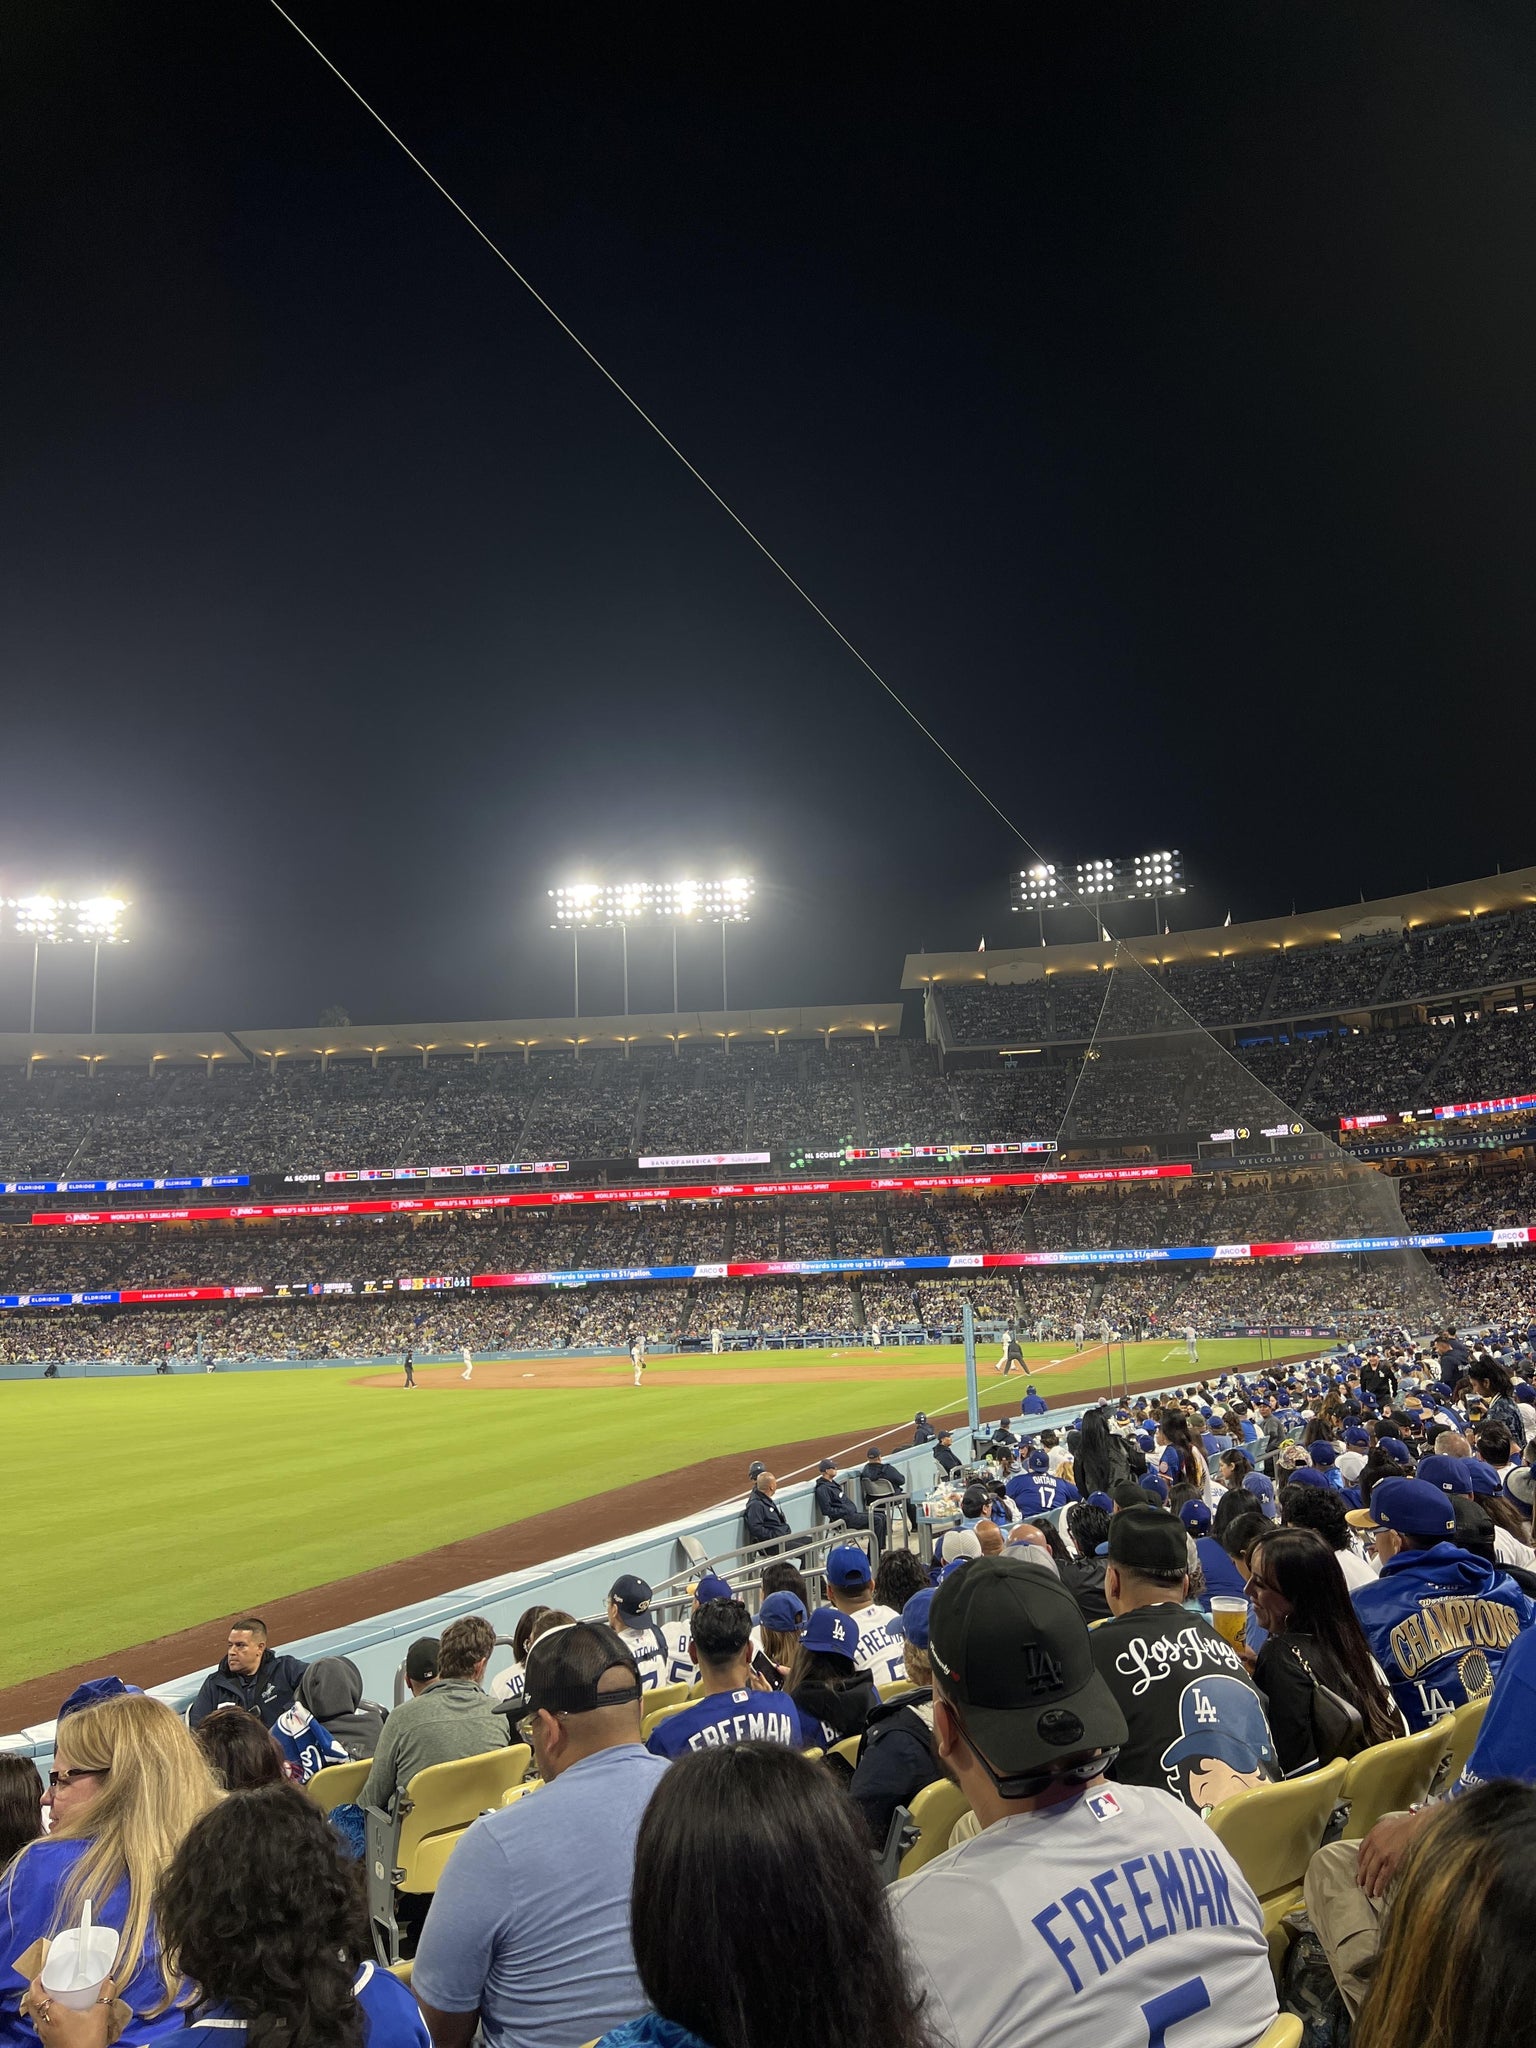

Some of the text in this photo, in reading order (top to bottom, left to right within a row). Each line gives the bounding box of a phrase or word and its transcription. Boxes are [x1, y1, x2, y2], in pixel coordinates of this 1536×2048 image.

[1375, 1145, 1404, 1154] FIELD
[1408, 1143, 1420, 1151] AT
[1425, 1139, 1468, 1149] DODGER
[1473, 1133, 1520, 1144] STADIUM
[1239, 1156, 1287, 1165] WELCOME
[294, 1173, 320, 1182] SCORES
[1331, 1241, 1362, 1249] Rewards
[1409, 1237, 1445, 1247] $1/gallon.
[1498, 1232, 1517, 1240] ARCO
[872, 1259, 906, 1268] $1/gallon.
[1134, 1250, 1169, 1260] $1/gallon.
[619, 1269, 652, 1278] $1/gallon.
[1034, 1475, 1057, 1488] OHTANI
[1039, 1486, 1056, 1509] 17
[832, 1618, 846, 1642] LA
[1390, 1598, 1521, 1680] CHAMPIONS
[856, 1626, 904, 1662] FREEM
[1023, 1641, 1064, 1694] LA
[1116, 1634, 1180, 1696] Los
[1192, 1688, 1218, 1723] LA
[1413, 1679, 1456, 1726] LA
[688, 1712, 792, 1752] FREEMAN
[1031, 1847, 1240, 1994] FREEMAN
